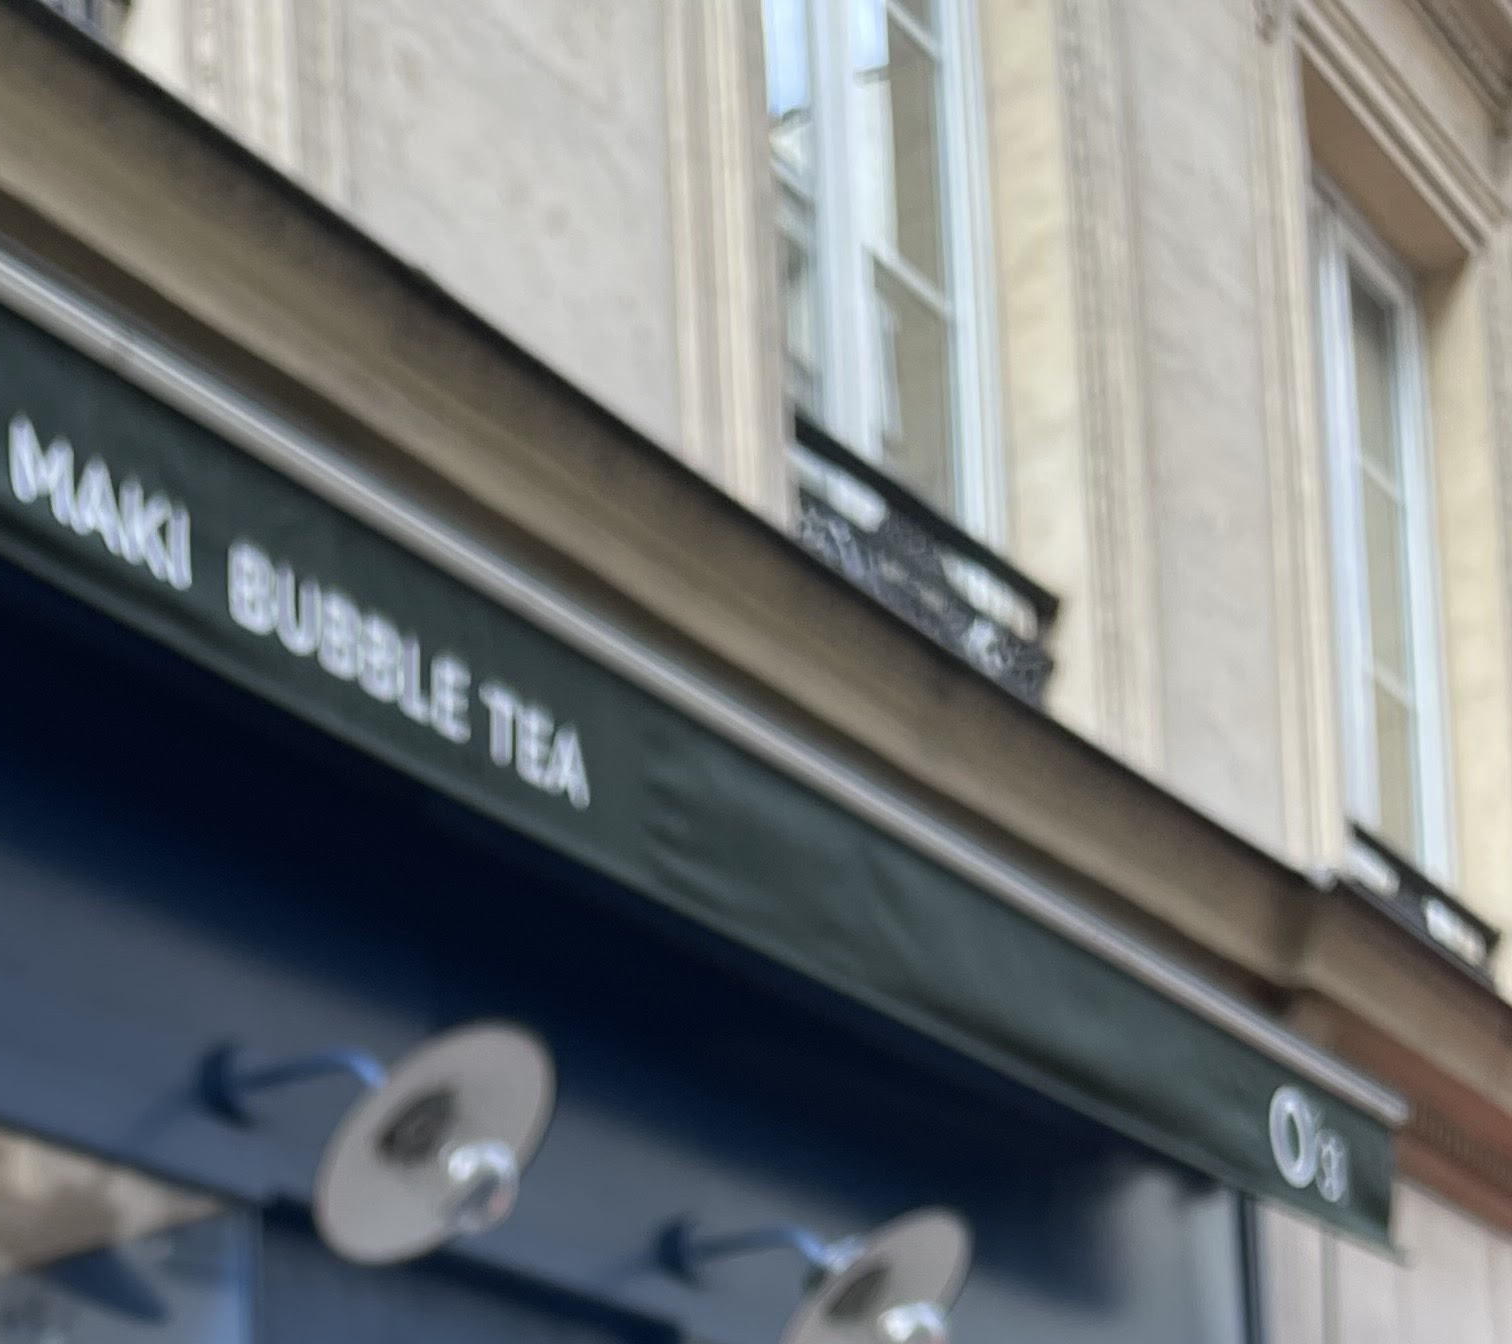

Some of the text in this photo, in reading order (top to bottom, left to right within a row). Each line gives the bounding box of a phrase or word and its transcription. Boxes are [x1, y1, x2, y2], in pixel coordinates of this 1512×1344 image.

[8, 415, 194, 592] MAKI
[227, 540, 473, 743] BUBBLE
[479, 683, 591, 808] TEA
